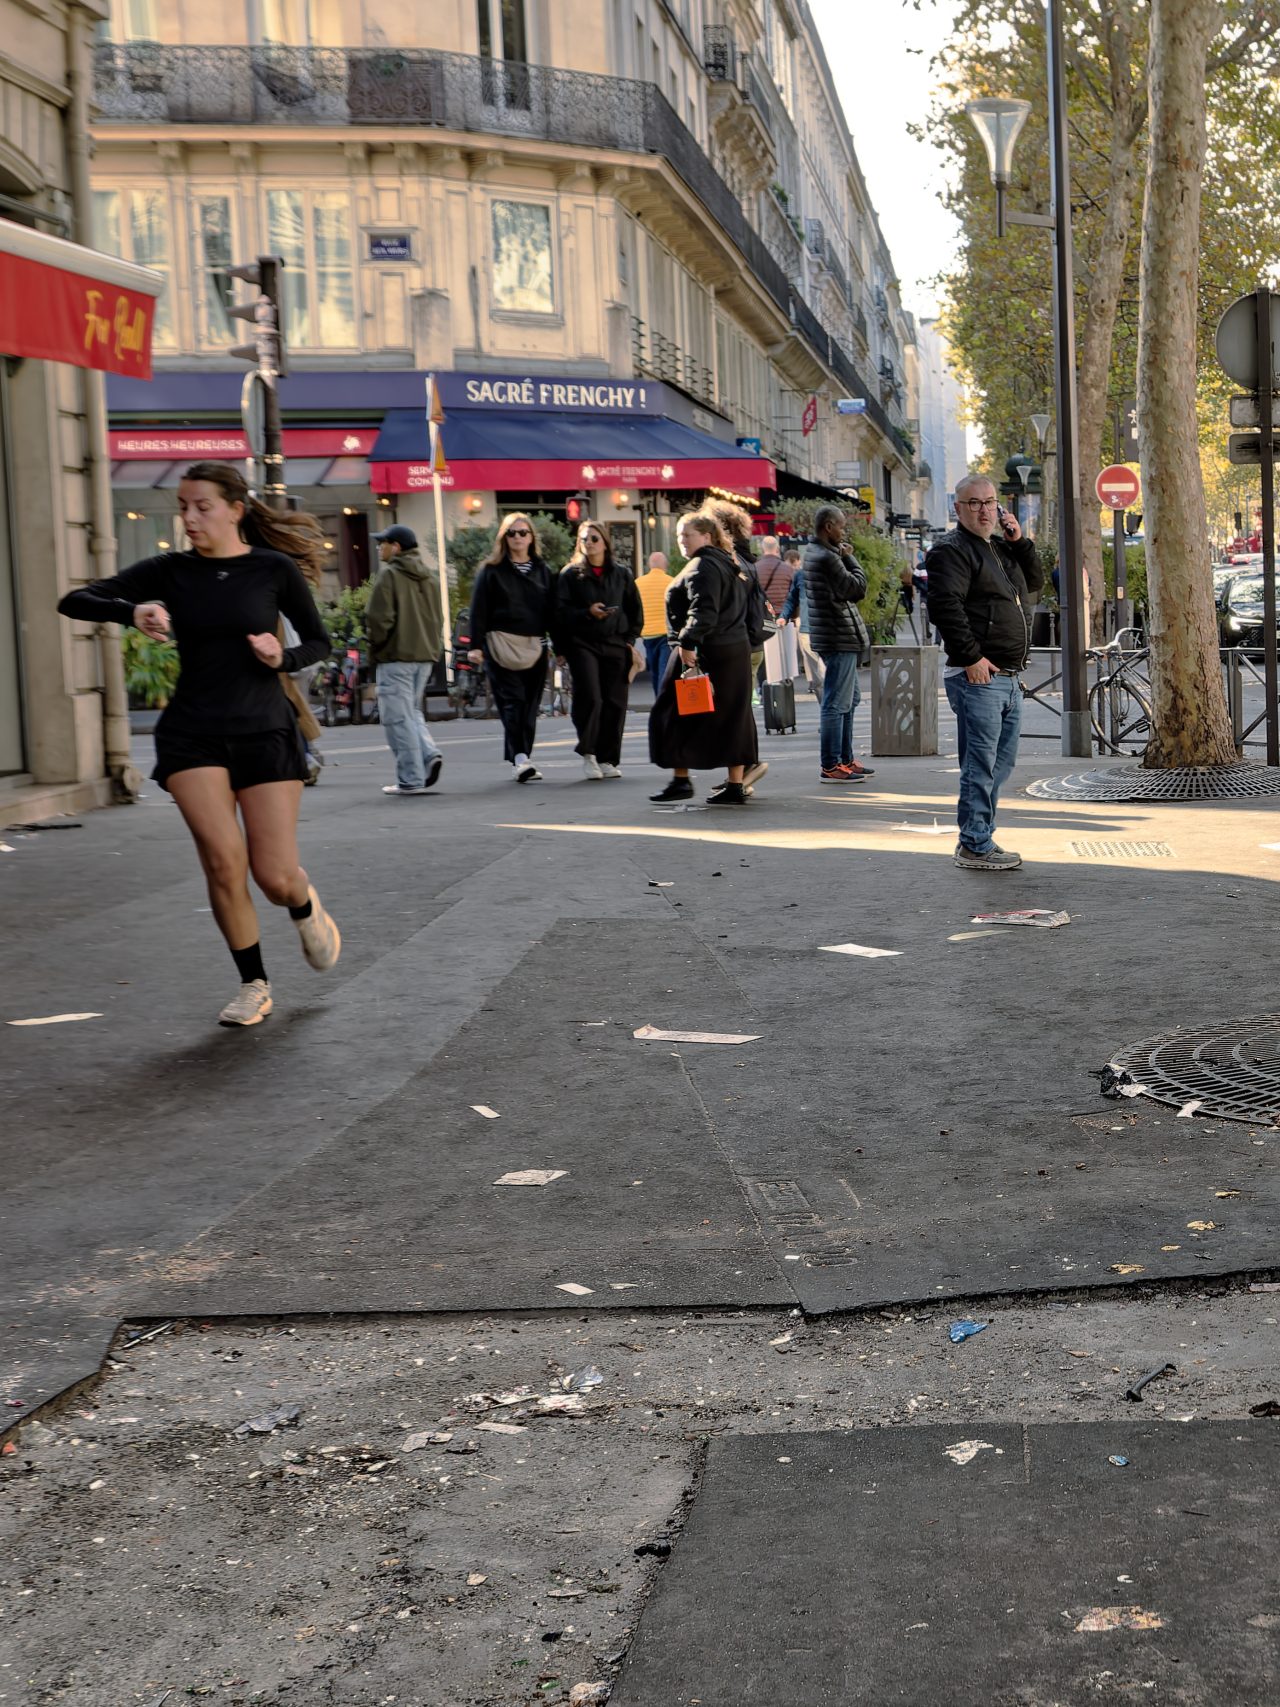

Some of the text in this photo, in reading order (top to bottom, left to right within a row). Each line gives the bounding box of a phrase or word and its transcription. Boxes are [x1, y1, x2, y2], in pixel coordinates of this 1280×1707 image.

[466, 378, 534, 404] SACRÉ
[540, 384, 633, 408] FRENCHY
[118, 439, 246, 450] HEURES HEUREUSES
[407, 477, 454, 487] CONTNU
